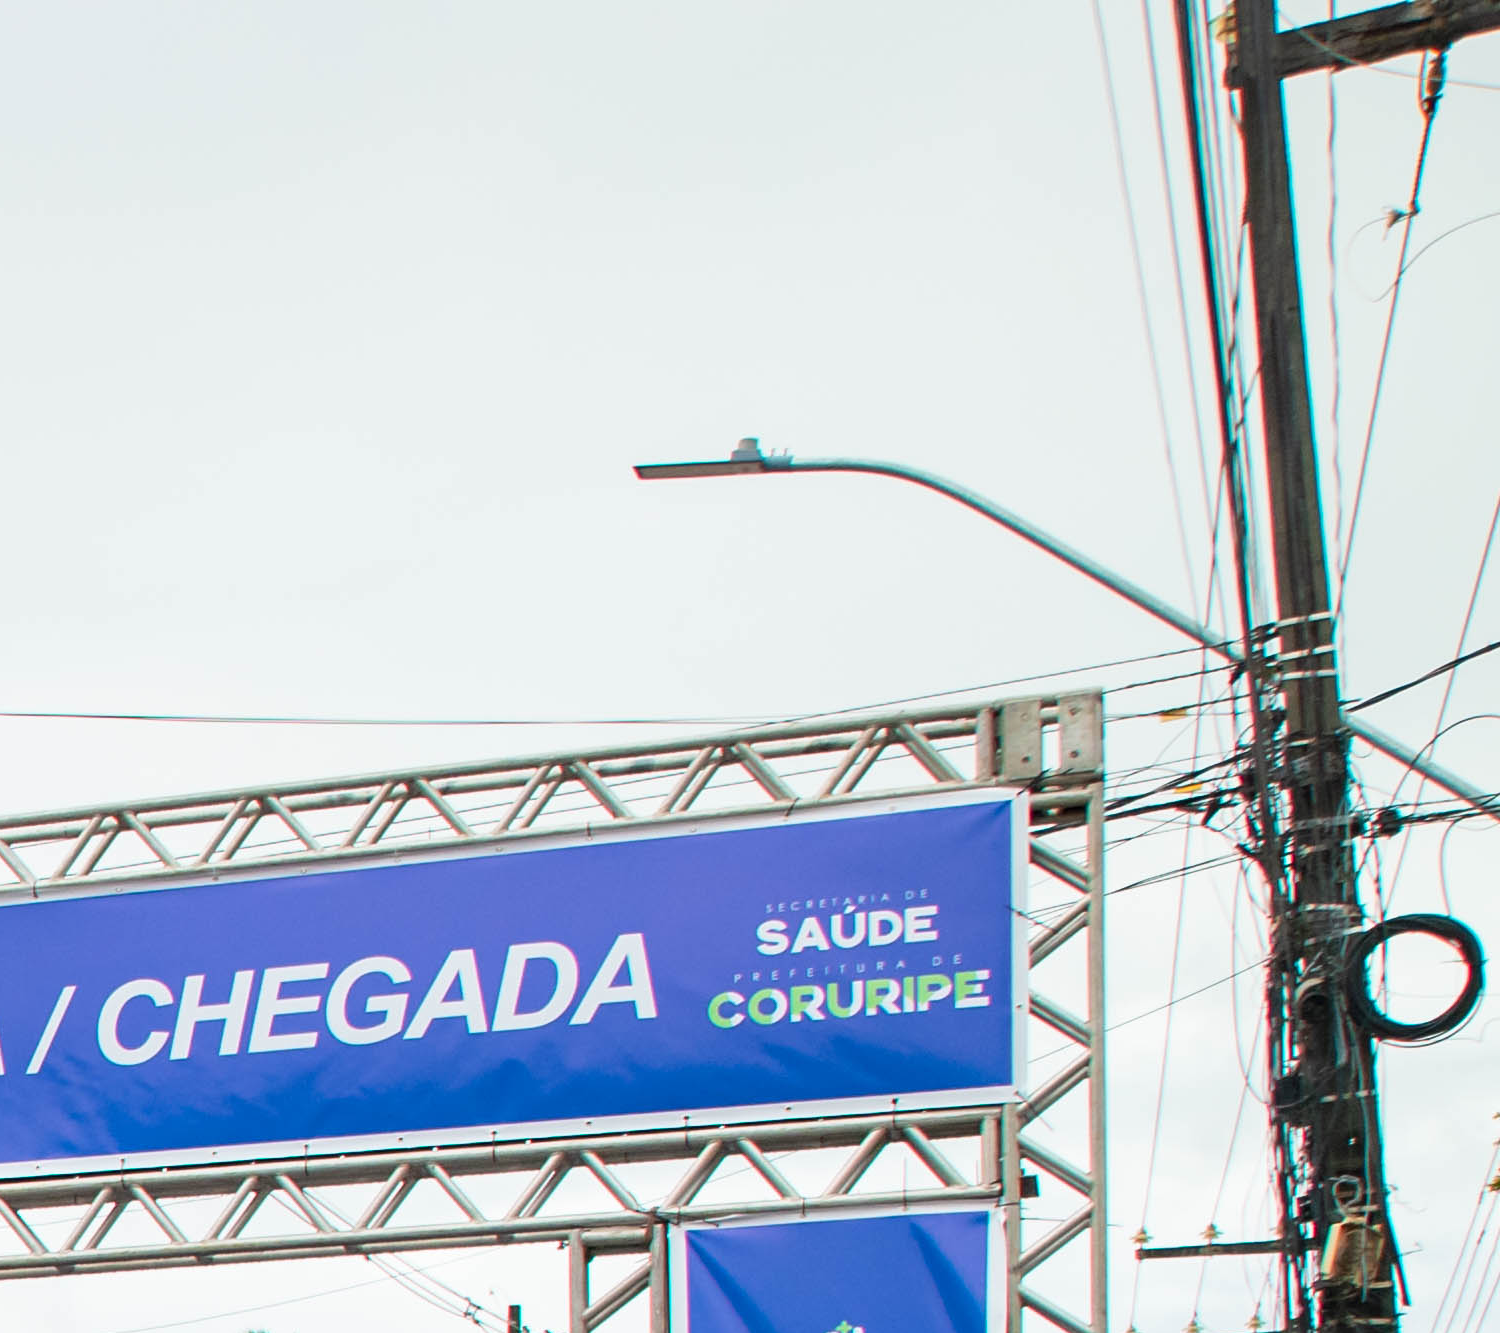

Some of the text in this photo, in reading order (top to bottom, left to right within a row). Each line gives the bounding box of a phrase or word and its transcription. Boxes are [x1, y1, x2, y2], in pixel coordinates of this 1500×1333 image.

[765, 887, 930, 914] SECRETARIA DE
[756, 904, 940, 955] SAÚDE
[931, 952, 963, 967] DE
[97, 932, 658, 1067] CHEGADA
[707, 969, 991, 1029] CORURIPE
